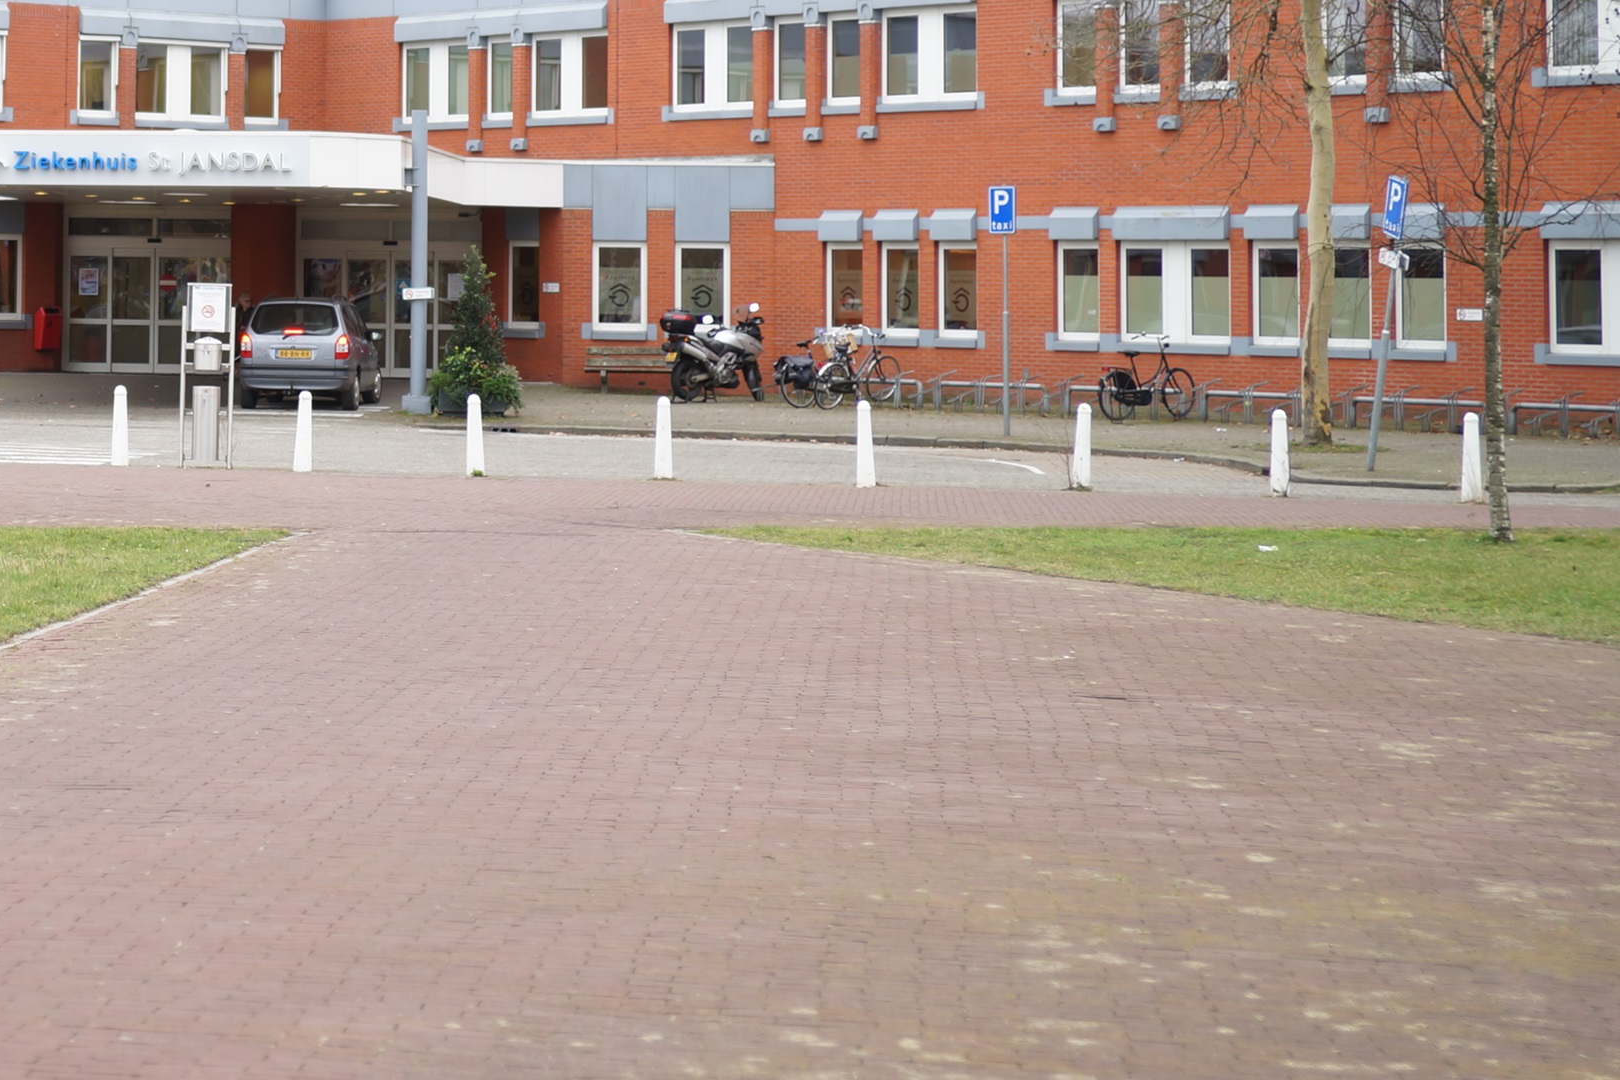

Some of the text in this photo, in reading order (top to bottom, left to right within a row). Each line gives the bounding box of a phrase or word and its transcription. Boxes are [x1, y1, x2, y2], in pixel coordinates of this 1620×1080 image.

[13, 150, 292, 175] Ziekenhuis St JANSDAL
[994, 190, 1009, 214] P
[1388, 181, 1402, 211] P
[992, 220, 1012, 230] taxi
